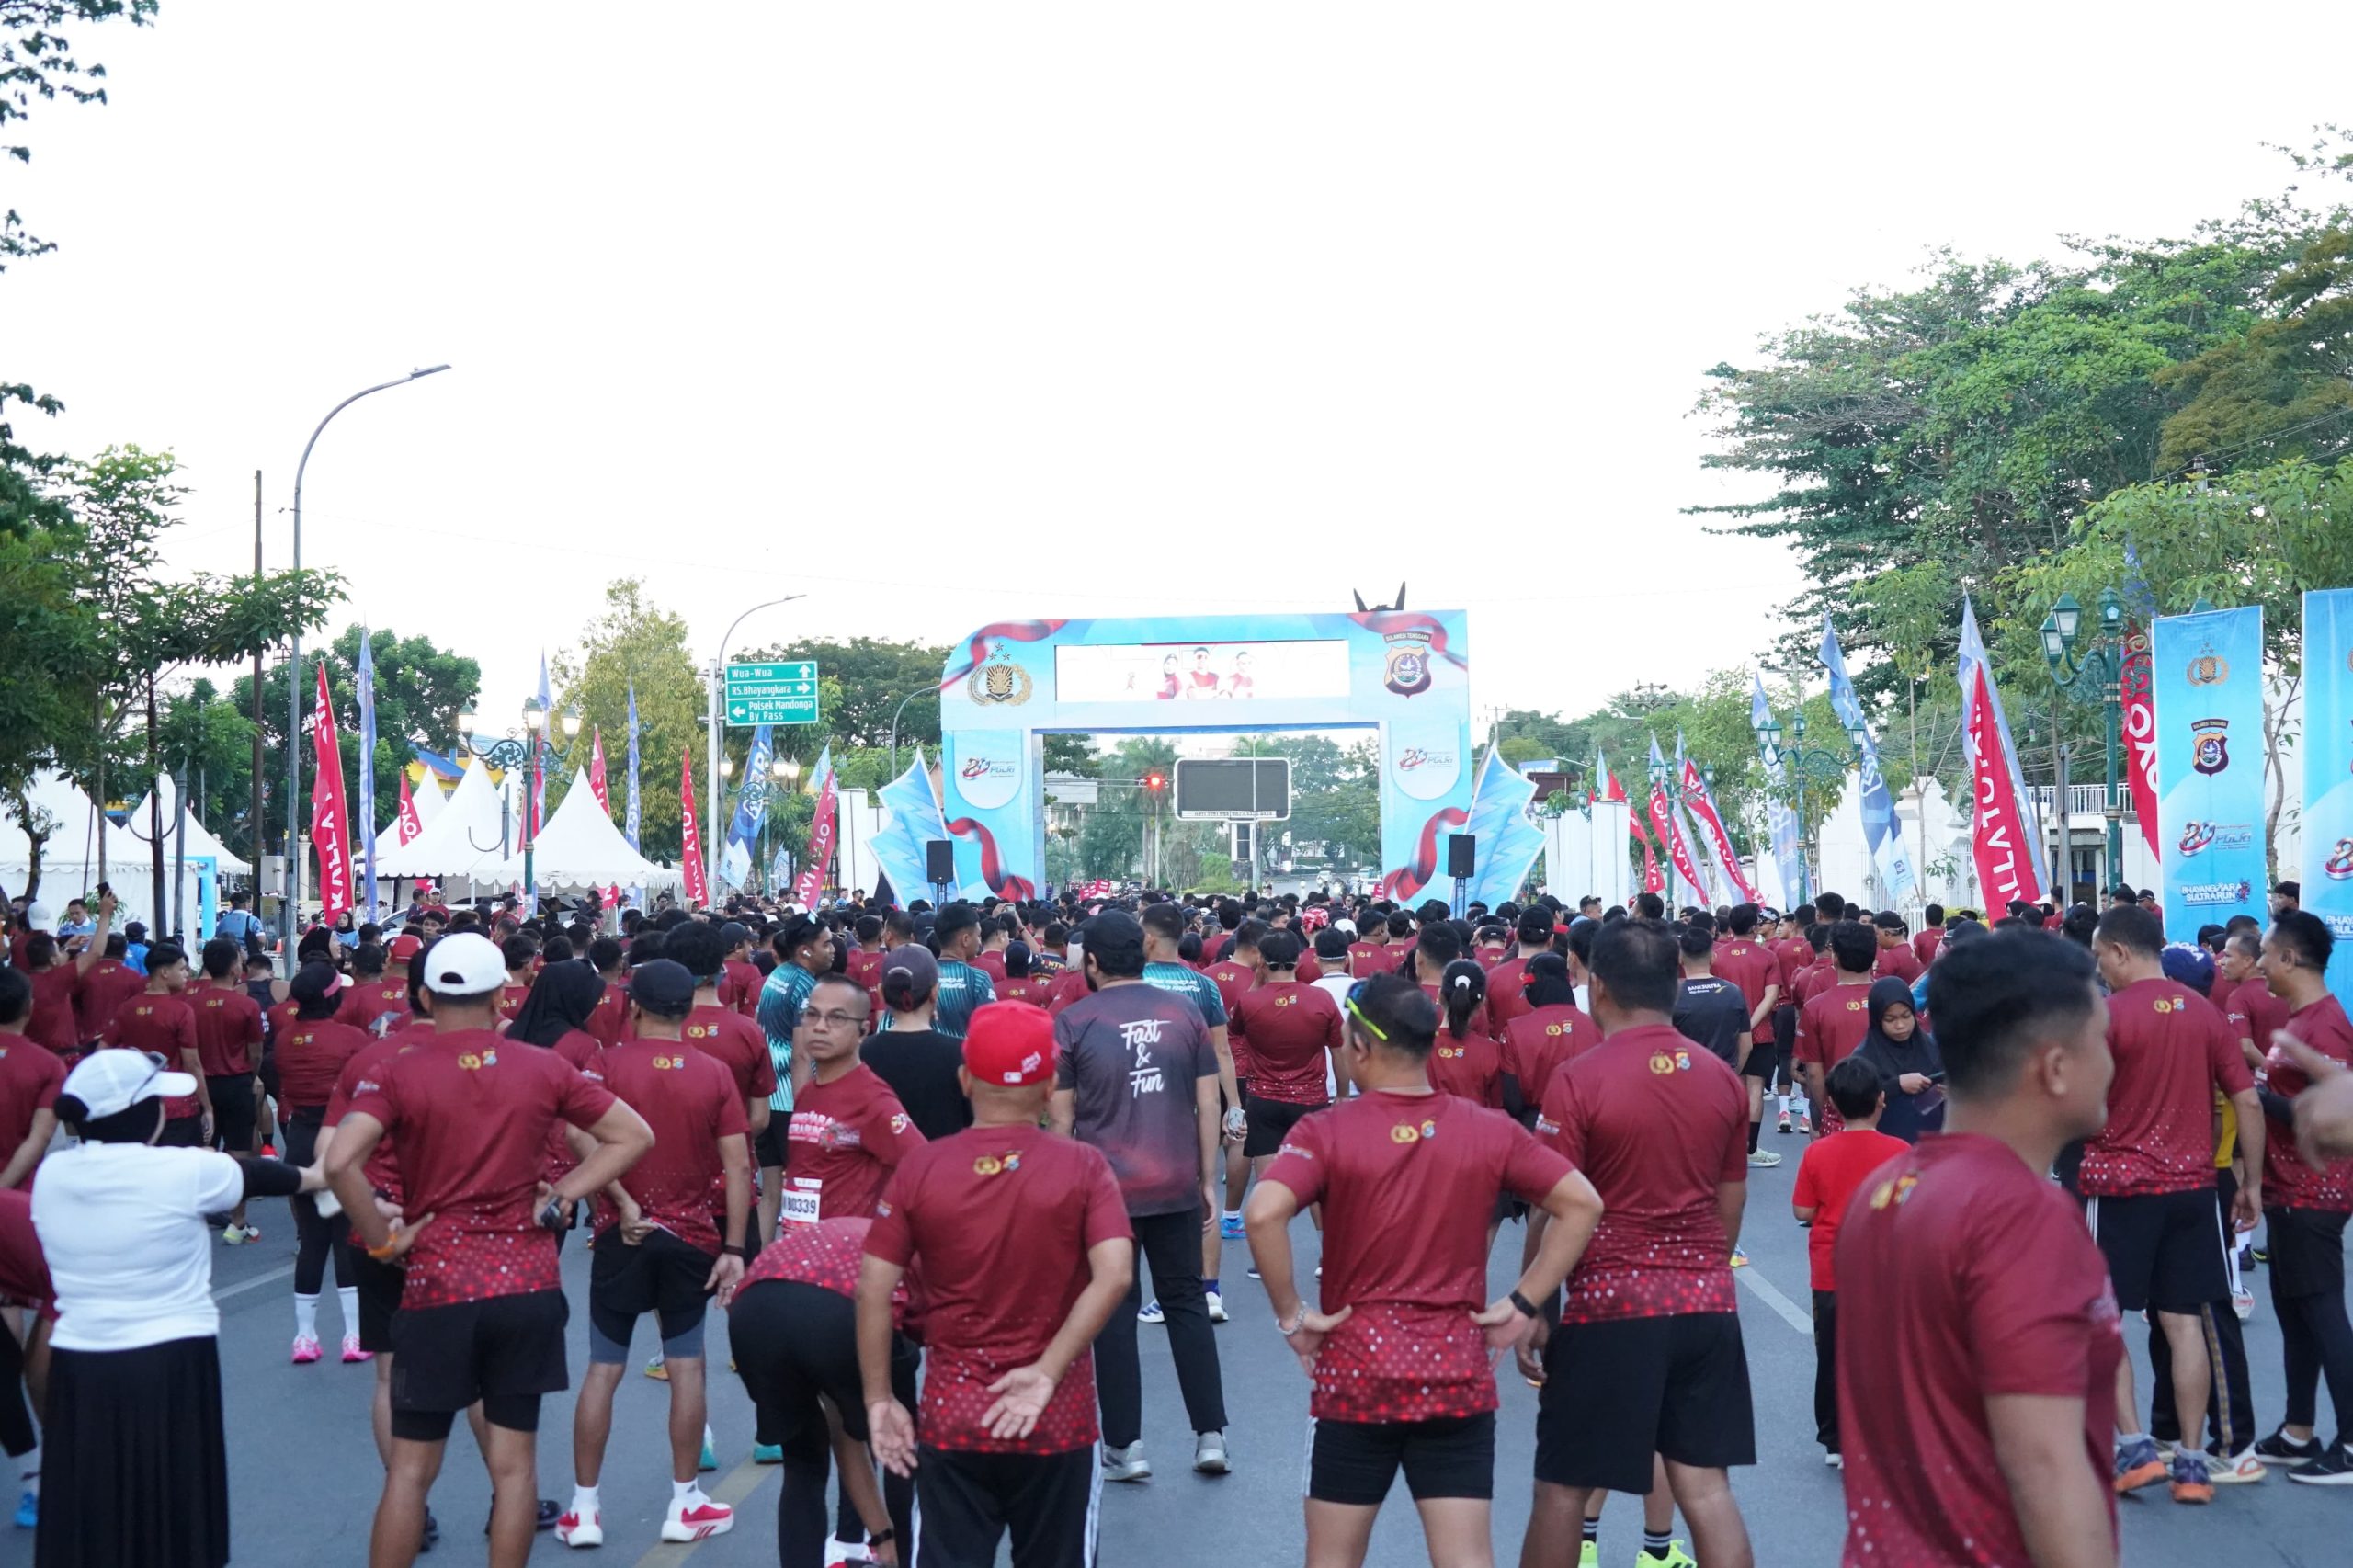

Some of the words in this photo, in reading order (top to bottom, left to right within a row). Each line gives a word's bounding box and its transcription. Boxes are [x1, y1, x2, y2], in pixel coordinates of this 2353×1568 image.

[731, 668, 773, 678] Wua-Wua
[732, 685, 791, 697] RS.Bhayangkara
[748, 700, 774, 710] Polsek
[775, 699, 813, 711] Mandonga
[748, 712, 759, 722] By
[763, 711, 784, 721] Pass
[2177, 821, 2216, 857] 80
[2181, 882, 2243, 894] BHAYANGKARA
[1119, 1019, 1172, 1050] Fast
[1135, 1042, 1151, 1068] &
[1129, 1067, 1165, 1099] Fun
